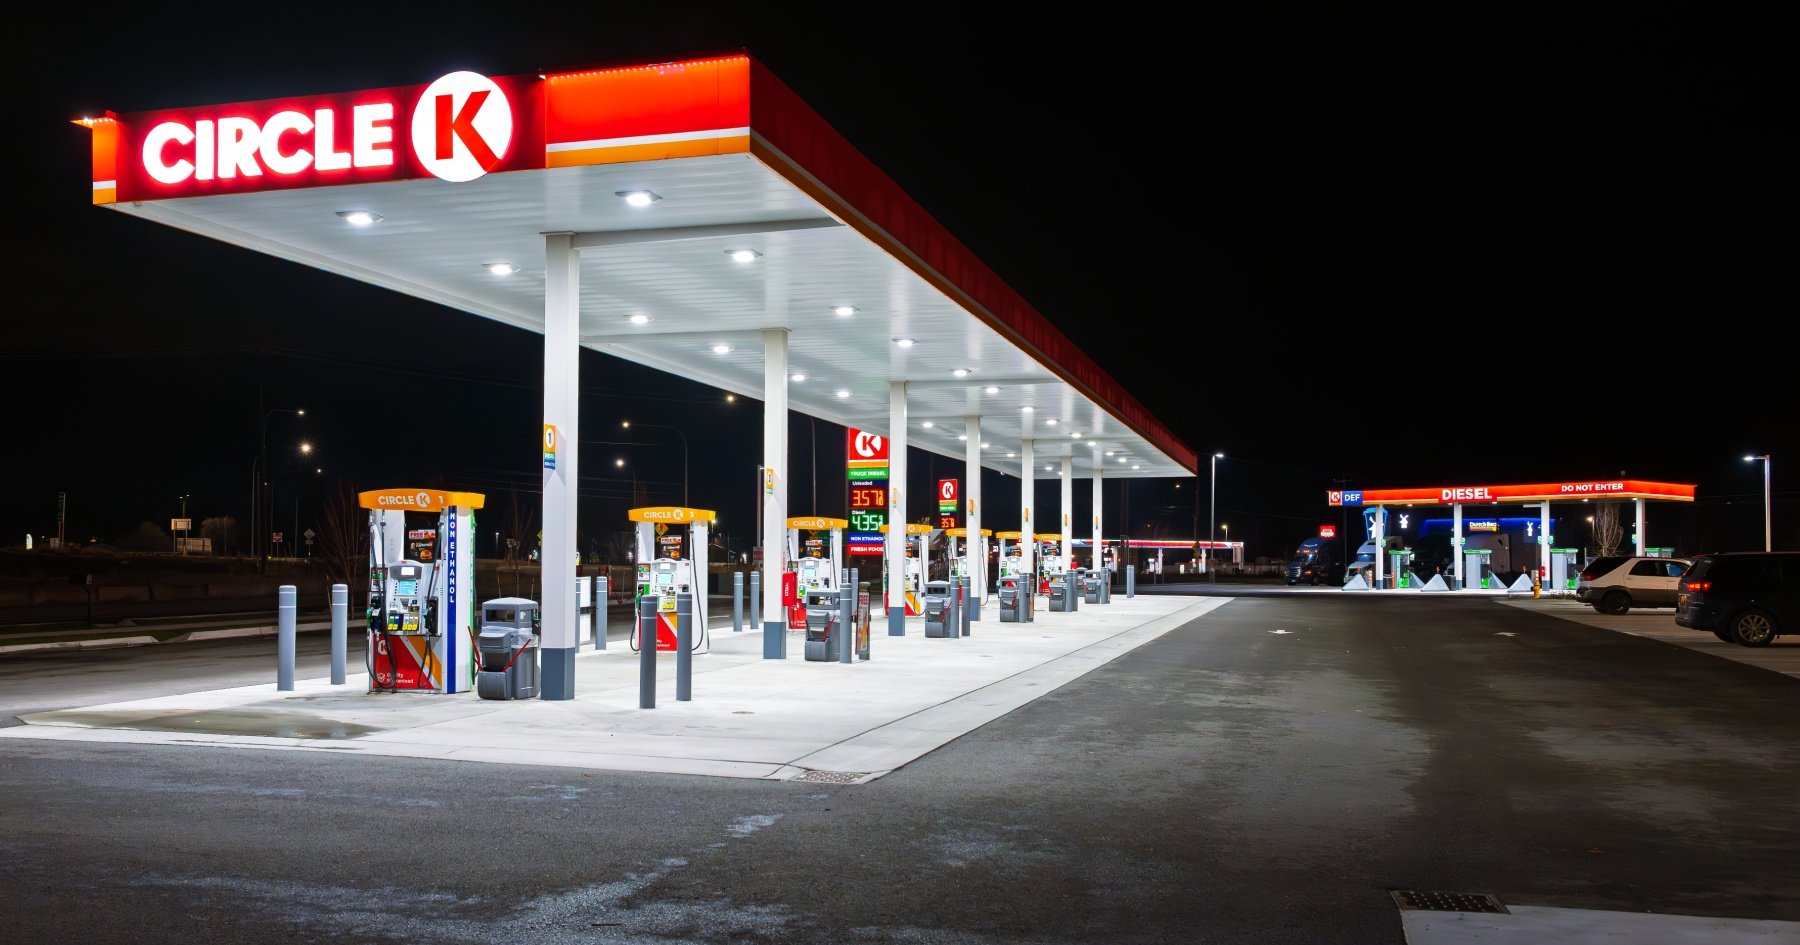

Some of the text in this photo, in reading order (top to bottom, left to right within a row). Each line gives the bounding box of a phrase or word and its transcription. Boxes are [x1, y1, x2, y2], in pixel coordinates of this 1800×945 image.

[142, 102, 394, 184] CIRCLE
[1575, 484, 1593, 492] NOT
[1595, 483, 1624, 491] ENTER
[1344, 493, 1361, 502] DEF
[1442, 488, 1493, 501] DIESEL
[378, 495, 415, 505] CIRCLE
[438, 495, 444, 505] 1
[643, 511, 672, 519] CIRCLE
